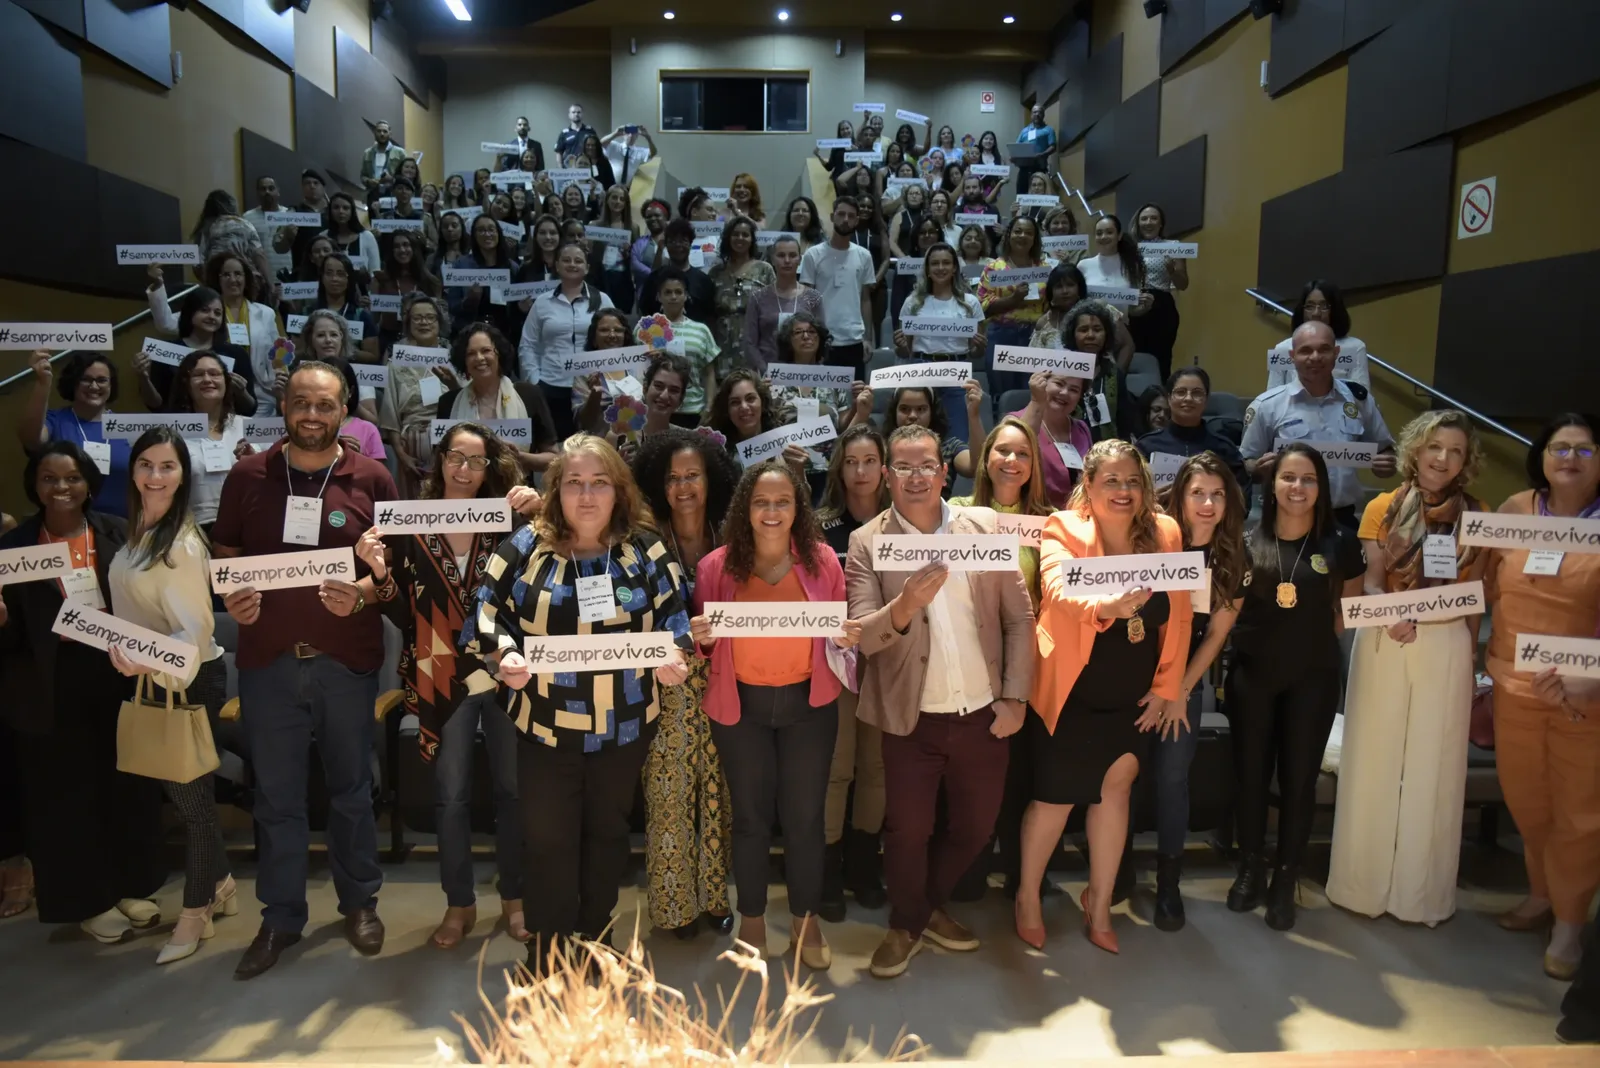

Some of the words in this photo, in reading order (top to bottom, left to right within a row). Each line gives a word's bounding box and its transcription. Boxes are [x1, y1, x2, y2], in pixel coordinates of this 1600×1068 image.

[586, 231, 628, 240] semprevivas
[120, 249, 195, 260] #semprevivas
[446, 272, 507, 282] #semprevivas
[905, 320, 974, 333] #semprevivas
[0, 329, 107, 345] #semprevivas
[564, 353, 647, 371] #semprevivas
[997, 350, 1090, 372] #semprevivas
[770, 367, 850, 383] #semprevivas
[743, 423, 830, 460] #semprevivas
[379, 507, 505, 526] #semprevivas
[1466, 520, 1600, 545] #sempreviva
[878, 543, 1012, 562] #semprevivas
[216, 559, 348, 585] #semprevivas
[1067, 563, 1199, 587] #semprevivas
[1348, 594, 1477, 619] #semprevivas
[708, 610, 840, 630] #semprevivas
[61, 609, 186, 669] #semprevivas
[530, 642, 667, 664] #semprevivas
